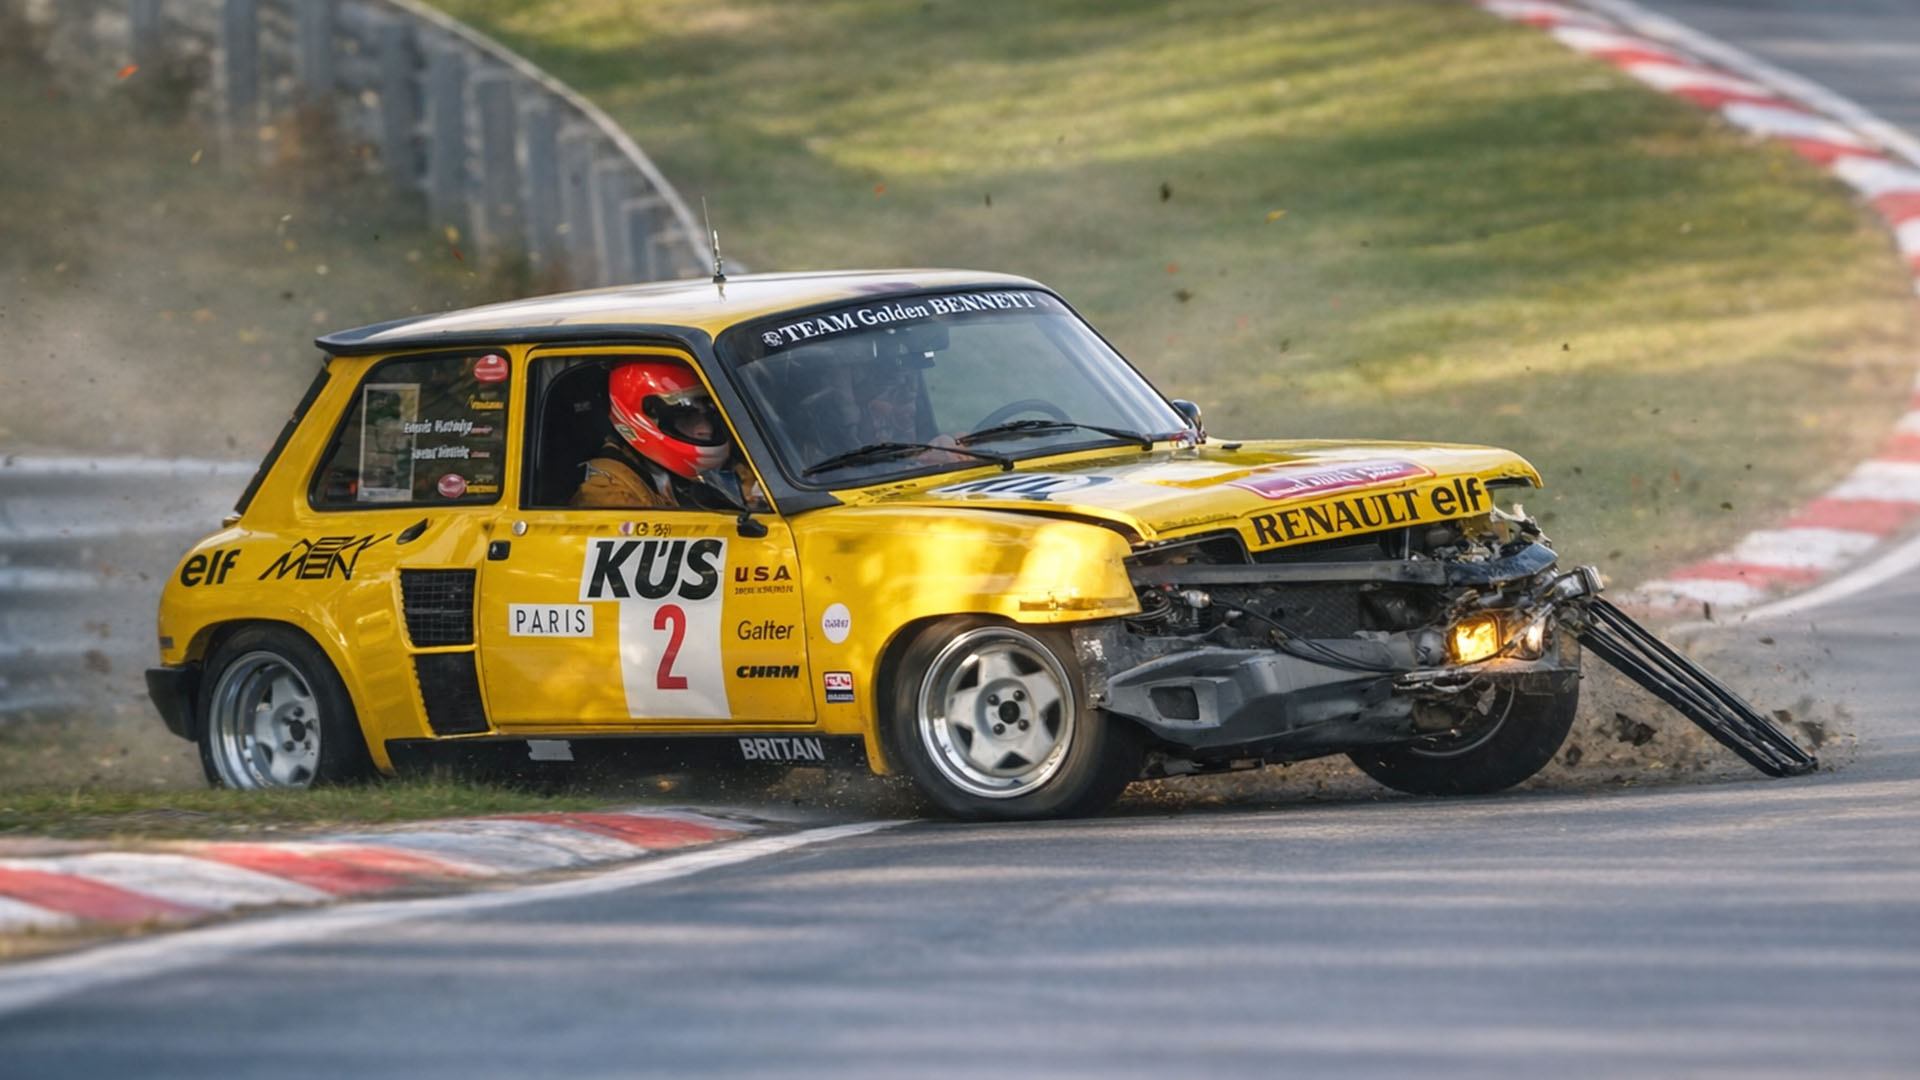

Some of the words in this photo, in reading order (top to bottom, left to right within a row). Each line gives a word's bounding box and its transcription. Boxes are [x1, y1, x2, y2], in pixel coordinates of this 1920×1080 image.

[780, 312, 857, 342] TEAM
[858, 304, 929, 325] Golden
[928, 292, 1036, 314] BENNETT
[1250, 489, 1421, 546] RENAULT
[1430, 477, 1482, 516] elf
[180, 549, 241, 587] elf
[516, 608, 587, 633] PARIS
[653, 604, 689, 690] 2
[740, 738, 824, 760] BRITAN
